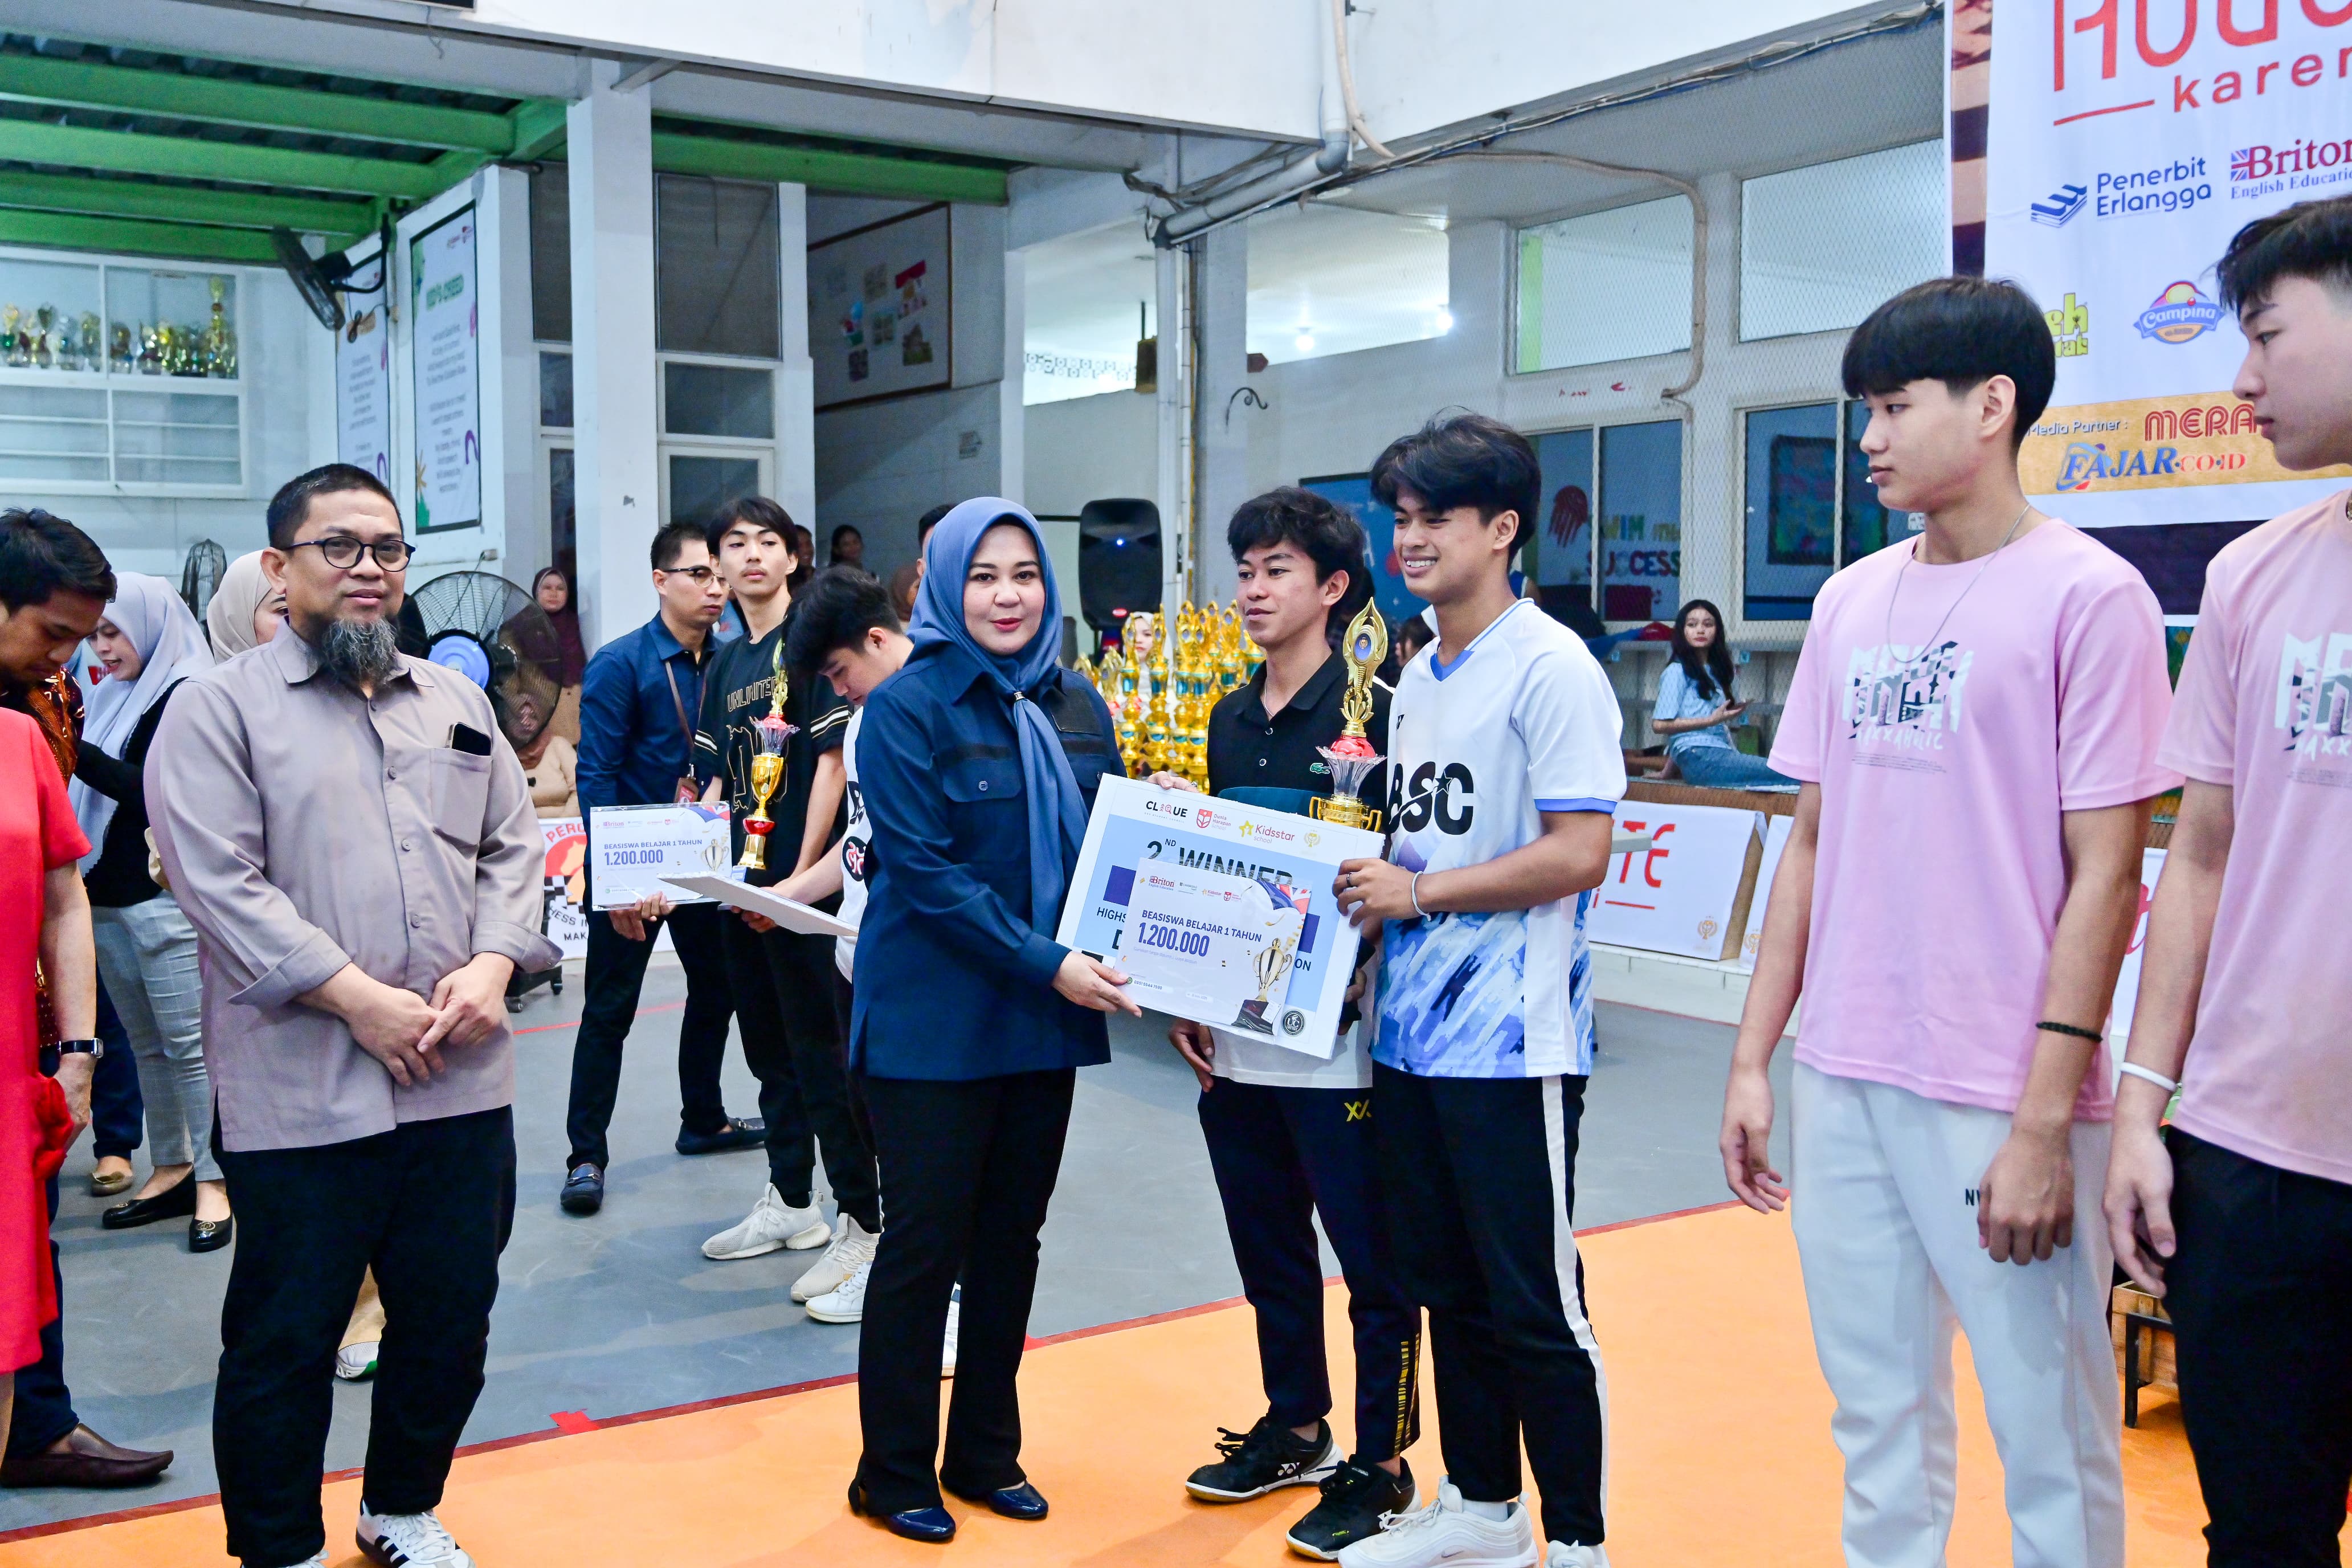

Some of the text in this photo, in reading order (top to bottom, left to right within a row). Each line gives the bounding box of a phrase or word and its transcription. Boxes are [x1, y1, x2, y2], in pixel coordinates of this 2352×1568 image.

[2097, 157, 2207, 194] Penerbit
[2231, 177, 2284, 199] English
[2097, 183, 2212, 216] Erlangga
[2142, 307, 2216, 329] Campina
[2073, 419, 2121, 435] Partner
[2145, 403, 2257, 441] MERA
[1165, 838, 1177, 847] ND
[1253, 835, 1272, 844] school
[1255, 824, 1295, 842] Kidsstar
[604, 849, 664, 865] 1.200.000
[1152, 876, 1175, 887] Briton
[1142, 909, 1262, 942] BEASISWA BELAJAR 1 TAHUN
[1138, 922, 1210, 957] 1.200.000
